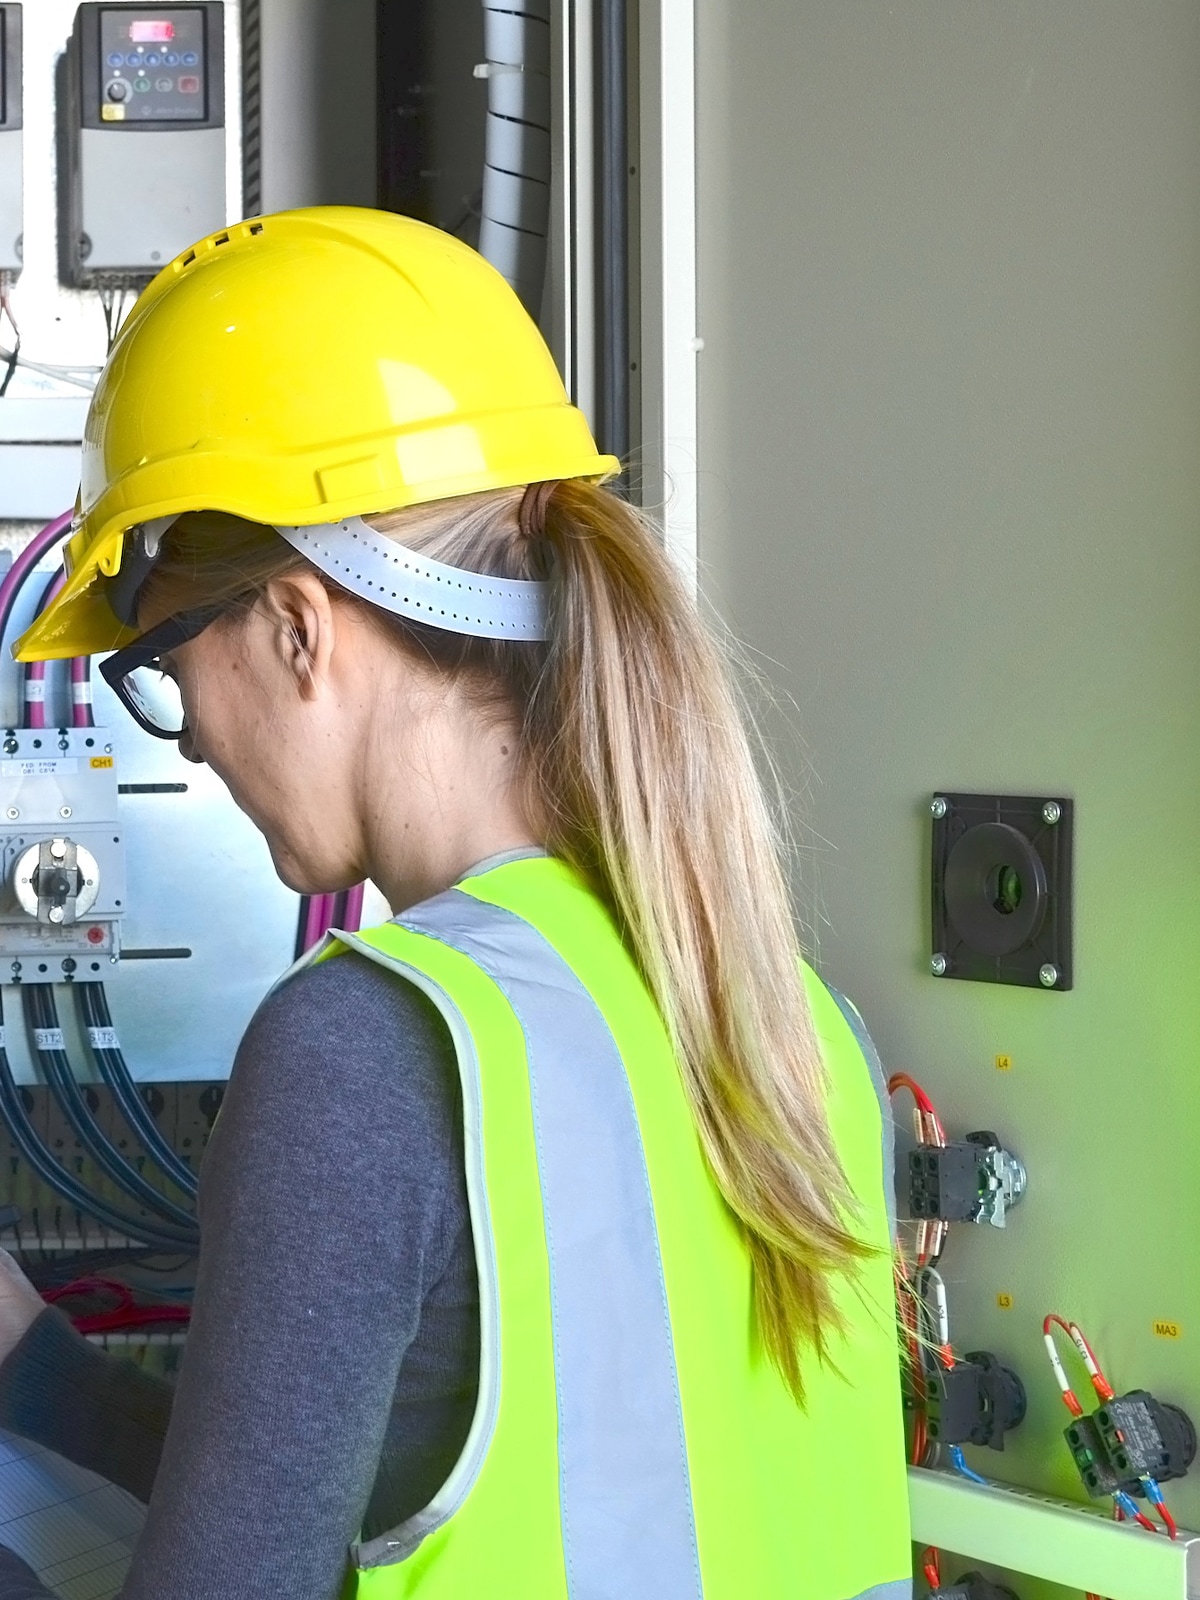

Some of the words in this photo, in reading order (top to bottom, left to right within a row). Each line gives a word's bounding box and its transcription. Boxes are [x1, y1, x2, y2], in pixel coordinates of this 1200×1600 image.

[91, 759, 112, 768] CH1
[36, 1034, 63, 1044] S1T2
[998, 1058, 1009, 1068] L4
[999, 1297, 1010, 1307] L3
[1156, 1324, 1177, 1336] MA3
